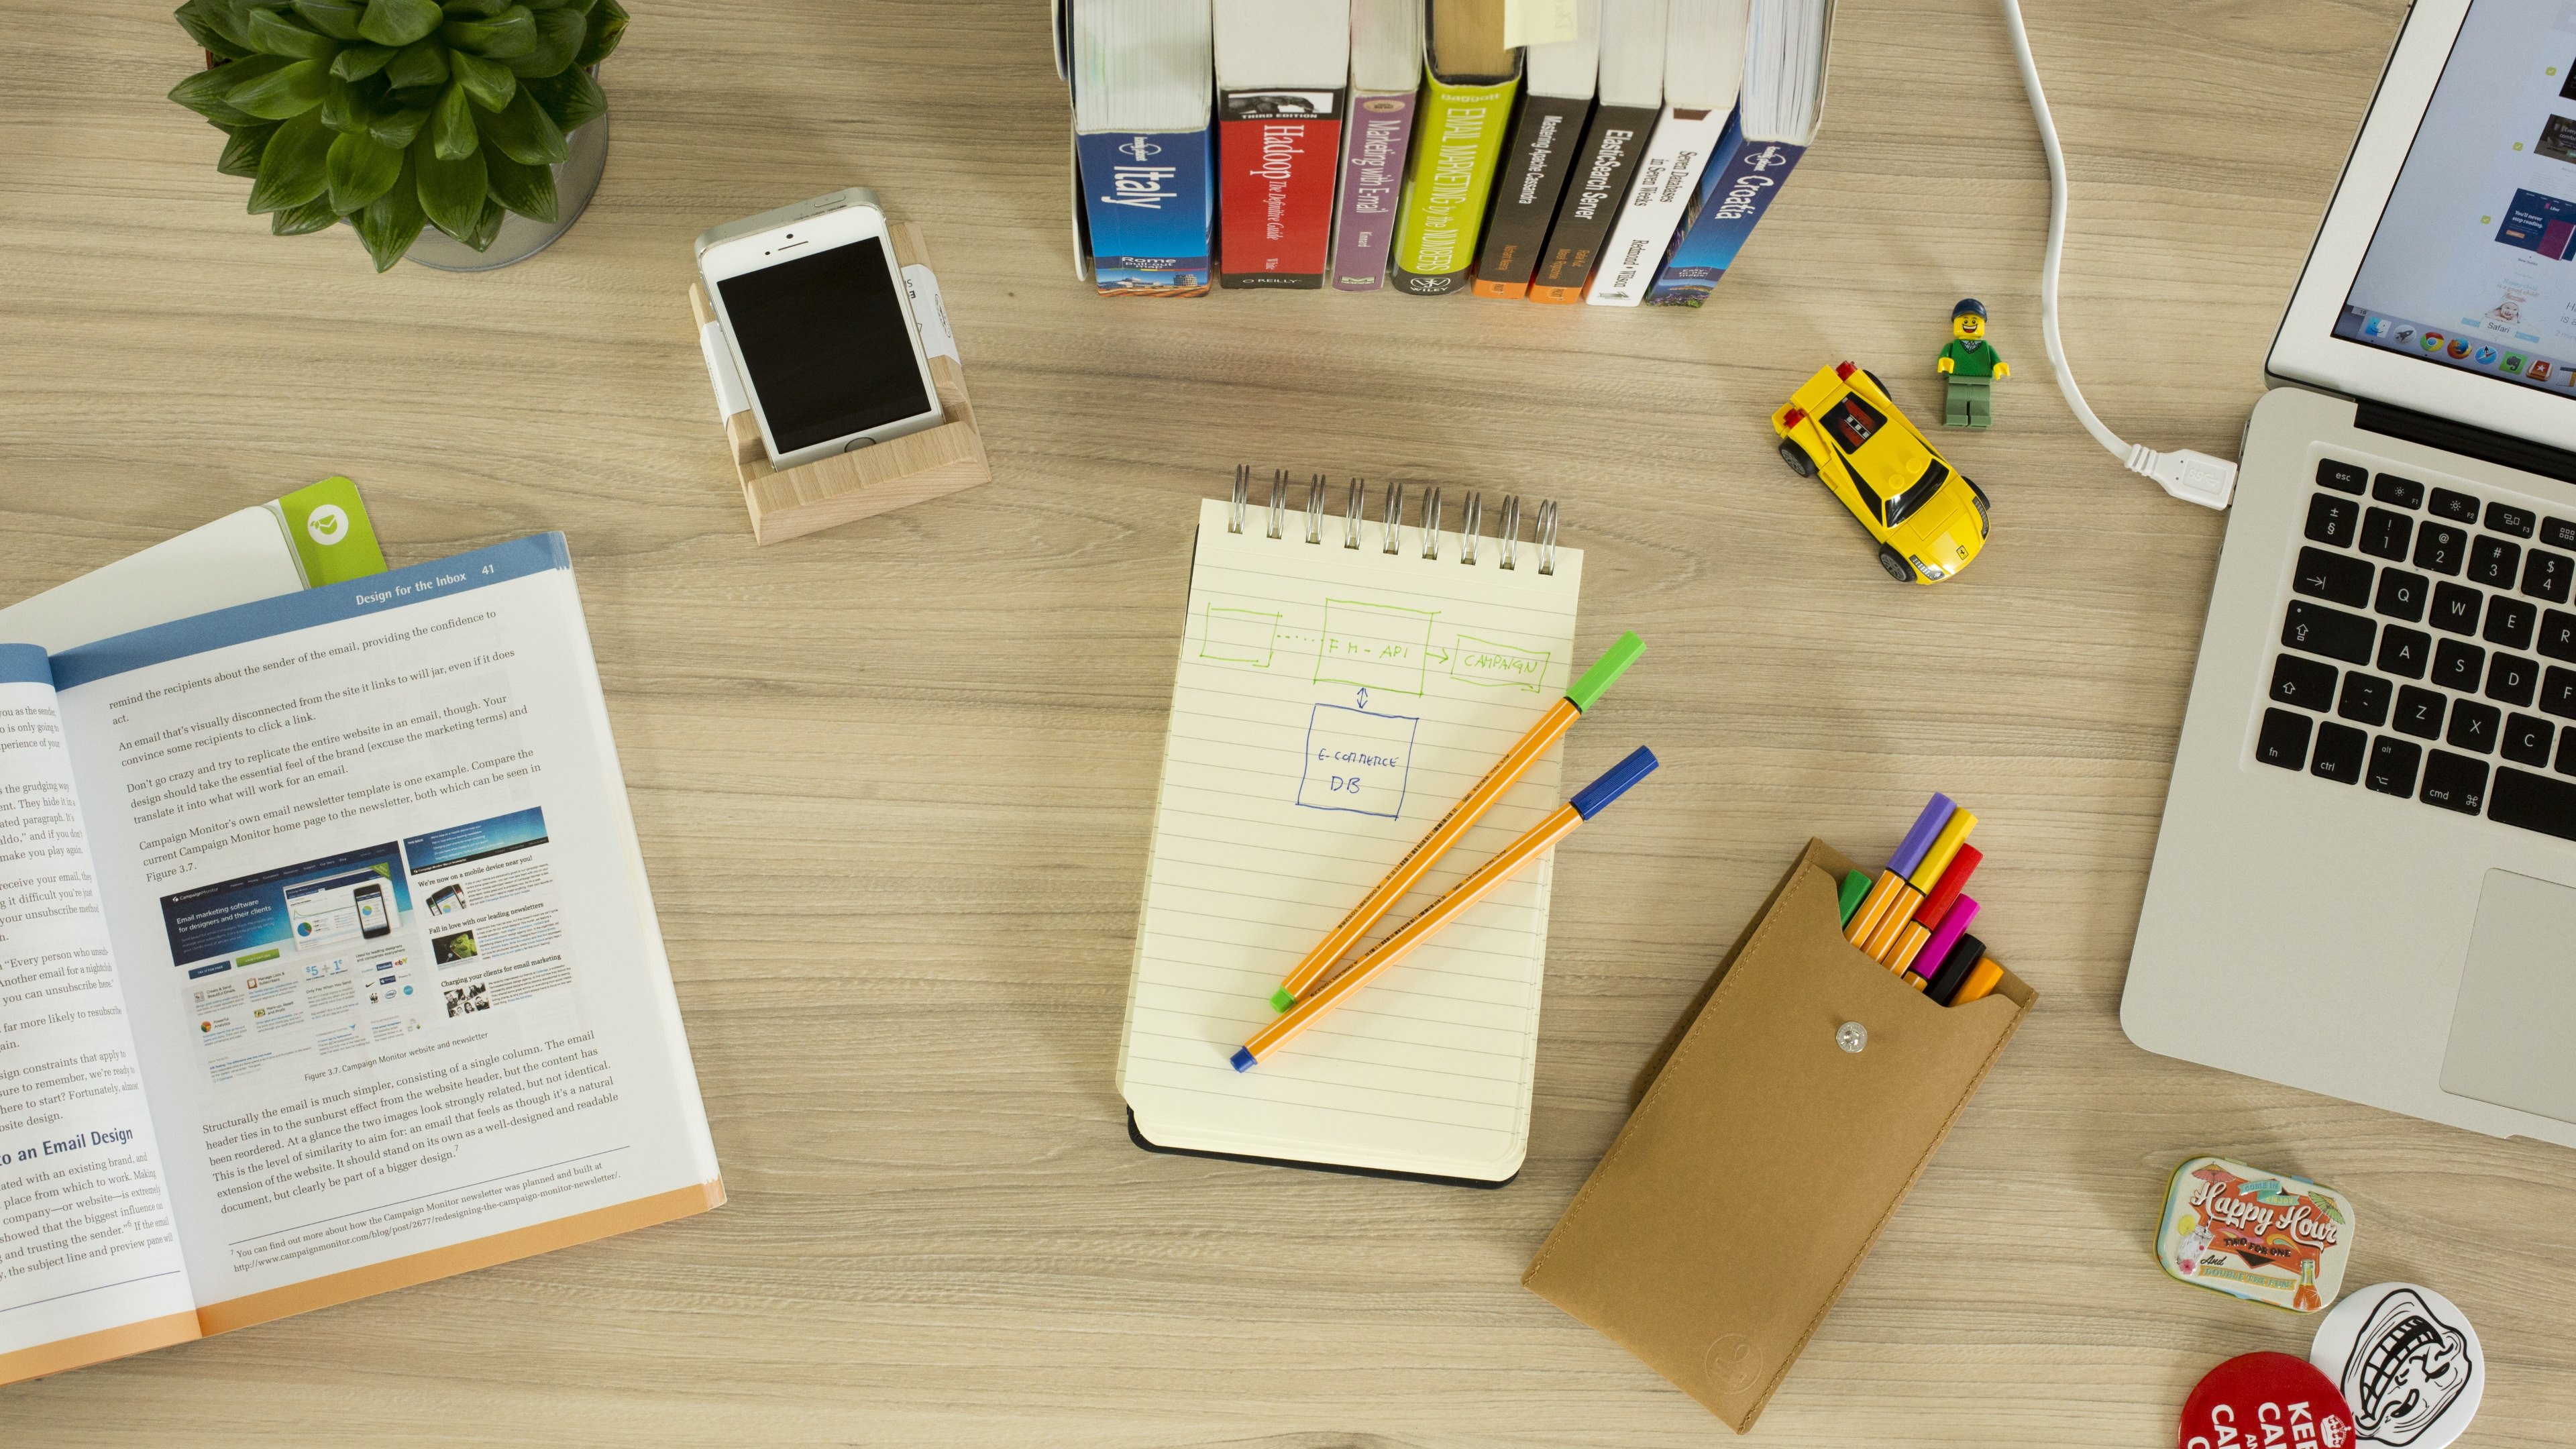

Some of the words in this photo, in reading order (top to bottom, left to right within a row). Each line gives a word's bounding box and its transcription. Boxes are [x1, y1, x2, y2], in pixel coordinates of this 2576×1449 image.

[1441, 94, 1501, 102] Baggott
[1442, 107, 1487, 142] EMAIL
[1531, 115, 1563, 149] Mastering
[1250, 125, 1305, 179] Hadoop
[1352, 120, 1401, 166] Marketing
[1528, 148, 1552, 172] Apache
[1585, 129, 1634, 191] ElasticSearch
[1672, 151, 1698, 169] Seven
[1360, 168, 1395, 186] with
[1430, 145, 1478, 204] MARKETING
[1642, 166, 1666, 185] Seven
[1101, 166, 1177, 209] Italy
[1269, 181, 1287, 192] The
[1519, 172, 1544, 205] Cassandra
[1660, 171, 1688, 203] Databases
[1356, 188, 1389, 213] E-mail
[1635, 186, 1658, 207] Weeks
[1715, 175, 1774, 219] Croatia
[1263, 193, 1286, 221] Definitive
[1574, 192, 1608, 220] Server
[1267, 223, 1284, 240] Guide
[1425, 217, 1454, 228] the
[2512, 216, 2523, 224] stop
[2523, 219, 2543, 229] reading.
[1358, 231, 1372, 247] Kinnard
[1623, 239, 1649, 266] Redmond
[1266, 258, 1279, 270] White
[1614, 270, 1637, 288] Wilson
[2487, 322, 2511, 333] Safari
[2336, 473, 2351, 481] esc
[2385, 537, 2388, 548] 1
[2436, 551, 2444, 562] 2
[2490, 564, 2497, 576] 3
[356, 590, 392, 605] Design
[395, 586, 412, 596] for
[415, 580, 433, 592] the
[435, 573, 467, 587] Inbox
[482, 564, 494, 575] 41
[2543, 579, 2551, 590] 4
[2398, 589, 2409, 602] Q
[2453, 601, 2465, 615] W
[2508, 615, 2516, 628] E
[2561, 630, 2570, 643] R
[2400, 646, 2409, 659] A
[109, 692, 144, 710] remind
[146, 690, 162, 700] the
[163, 678, 212, 695] recipients
[214, 669, 242, 683] about
[244, 666, 260, 676] the
[262, 658, 295, 672] sender
[298, 652, 308, 663] of
[310, 651, 326, 660] the
[329, 641, 360, 656] email,
[362, 632, 411, 651] providing
[412, 627, 428, 637] the
[431, 614, 484, 633] confidence
[1464, 654, 1538, 675] CAMPAIGN
[2456, 659, 2464, 672] S
[2509, 673, 2518, 685] D
[2564, 687, 2572, 698] F
[2416, 706, 2426, 719] Z
[2470, 720, 2481, 733] X
[2525, 735, 2534, 747] C
[1318, 747, 1399, 767] E-COMMERCE
[2269, 747, 2277, 757] fn
[2321, 762, 2334, 771] ctrl
[1330, 775, 1361, 794] DB
[2430, 790, 2449, 800] cmd
[417, 879, 436, 888] We're
[464, 867, 485, 877] mobile
[485, 863, 504, 871] device
[519, 855, 533, 865] you!
[304, 1071, 326, 1082] Figure
[327, 1067, 341, 1076] 3.7.
[342, 1059, 377, 1072] Campaign
[378, 1052, 407, 1063] Monitor
[409, 1045, 435, 1057] website
[437, 1040, 451, 1050] and
[452, 1032, 488, 1046] newsletter
[17, 1147, 38, 1161] an
[43, 1134, 87, 1156] Email
[91, 1127, 133, 1147] Design
[2244, 1181, 2268, 1191] COME
[2269, 1180, 2279, 1190] IN
[2265, 1195, 2295, 1204] ENJOY
[2190, 1181, 2274, 1236] Happy
[2275, 1205, 2338, 1253] Hour
[2223, 1237, 2248, 1247] TWO
[2248, 1242, 2269, 1256] FOR
[2269, 1247, 2292, 1258] ONE
[2200, 1254, 2228, 1267] And
[2204, 1267, 2245, 1283] DOUBLE
[2247, 1275, 2267, 1286] THE
